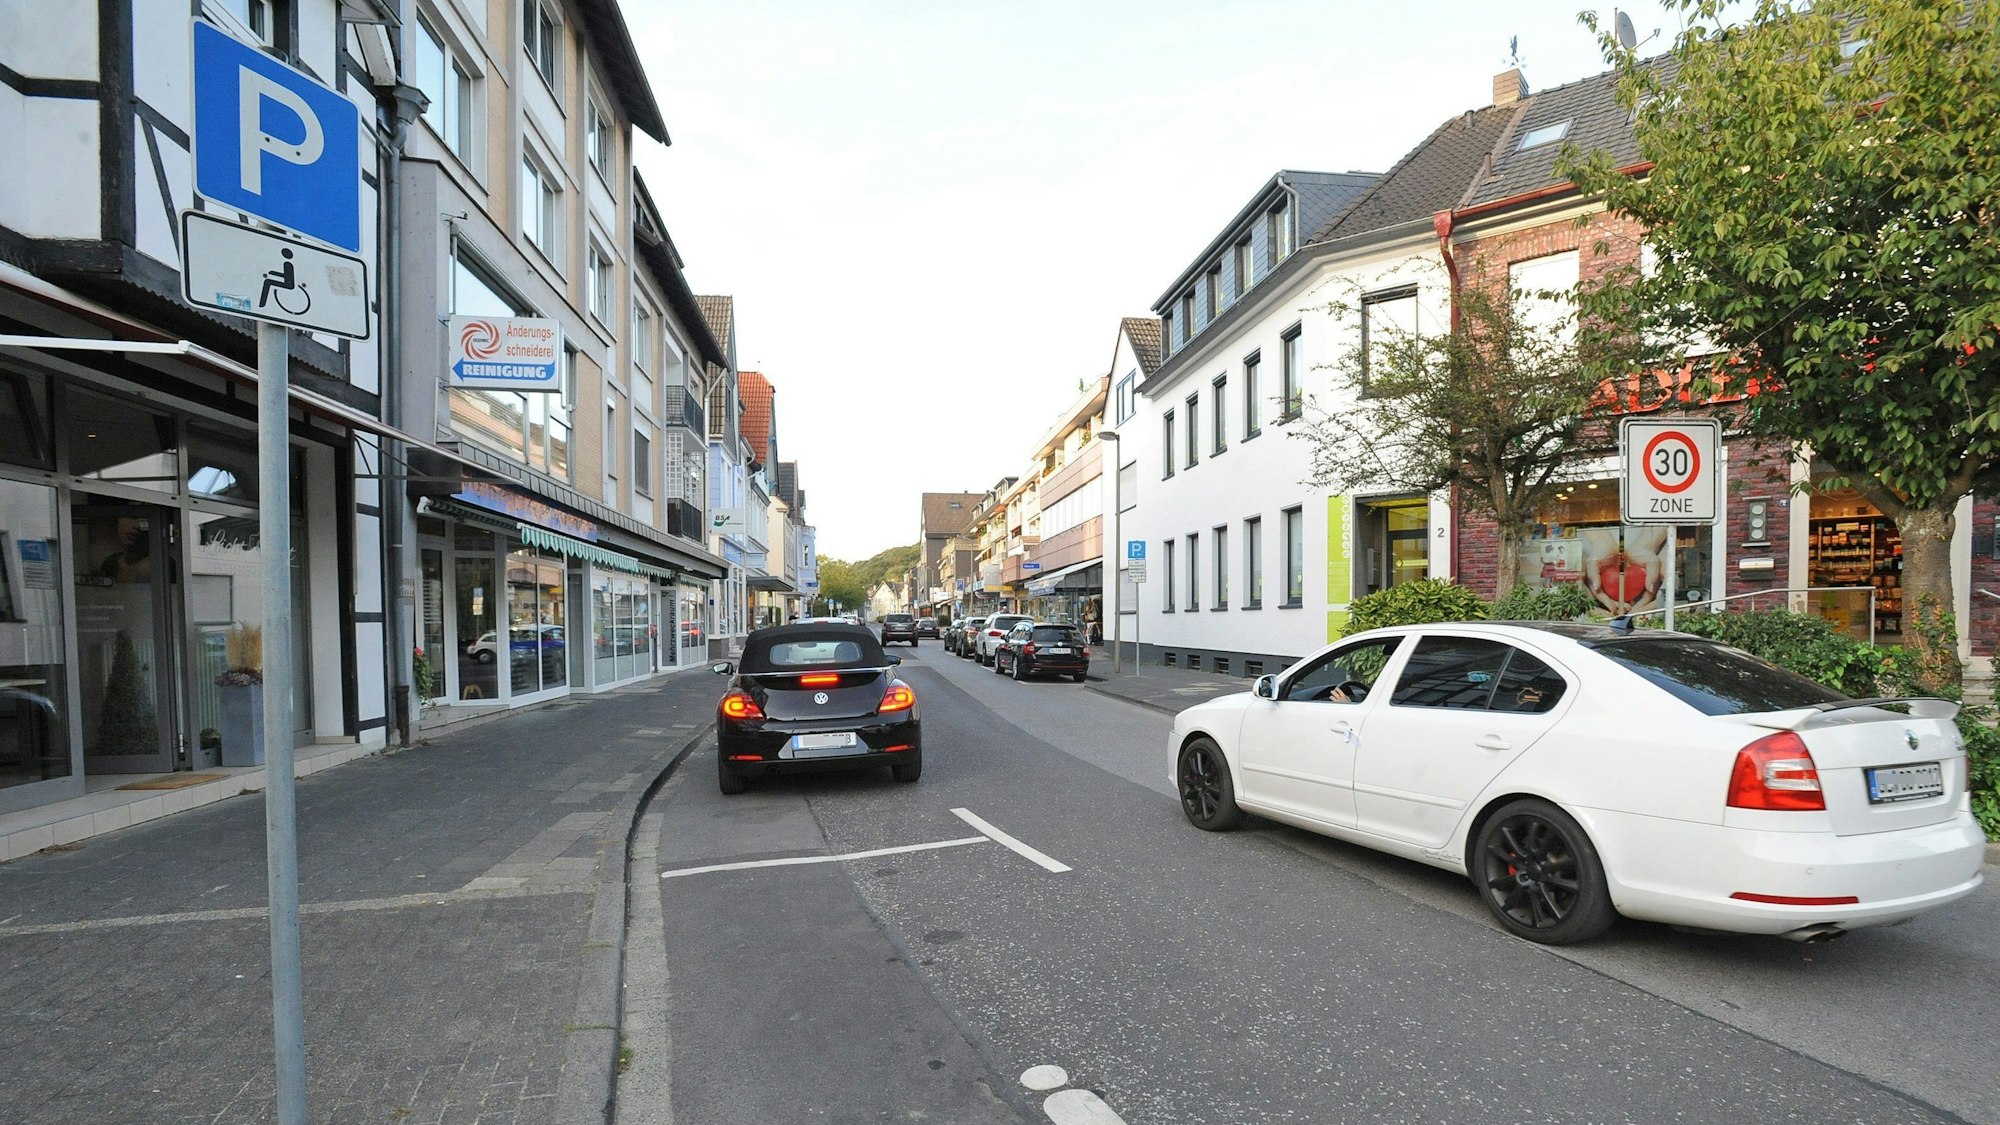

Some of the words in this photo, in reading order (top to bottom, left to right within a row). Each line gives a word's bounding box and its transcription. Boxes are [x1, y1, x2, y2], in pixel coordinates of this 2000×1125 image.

[239, 64, 325, 196] P
[506, 321, 555, 342] Änderungs-
[506, 342, 554, 358] schneiderei
[462, 364, 547, 379] REINIGUNG
[1655, 448, 1688, 476] 30
[1650, 498, 1694, 513] ZONE
[1437, 527, 1445, 538] 2
[1132, 543, 1142, 557] P
